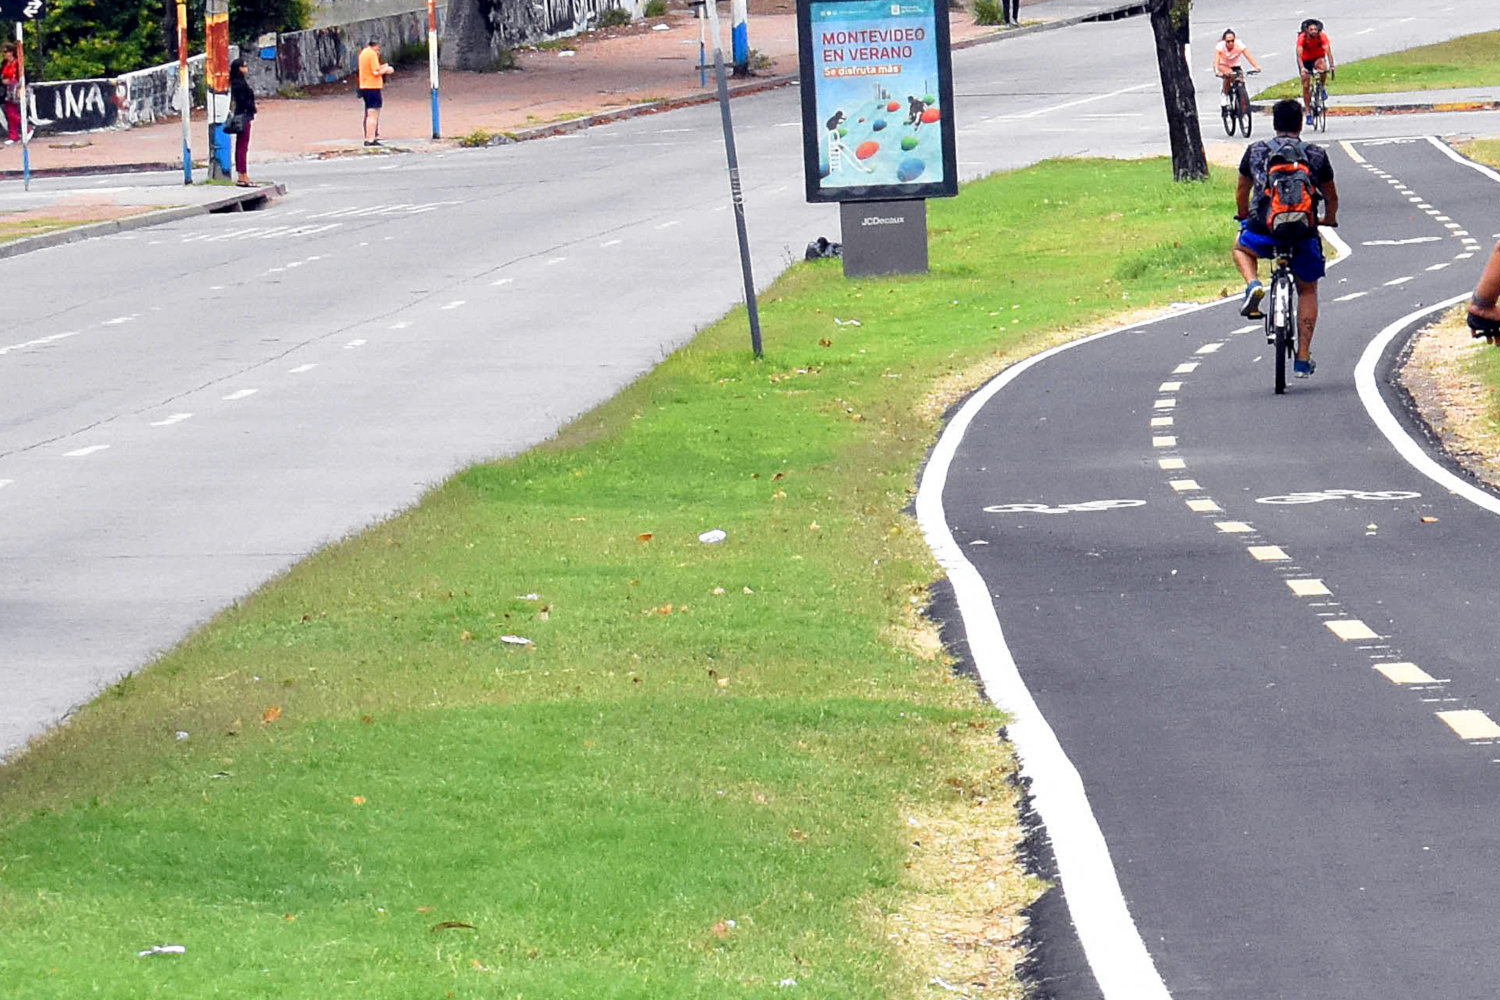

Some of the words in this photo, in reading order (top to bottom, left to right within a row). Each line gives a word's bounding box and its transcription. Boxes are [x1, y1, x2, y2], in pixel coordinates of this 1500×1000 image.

[822, 28, 925, 46] MONTEVIDEO
[823, 49, 844, 62] EN
[848, 46, 912, 61] VERANO
[824, 67, 836, 76] Se
[838, 66, 876, 76] disfruta
[878, 65, 899, 74] más
[861, 216, 905, 226] JCDecaux
